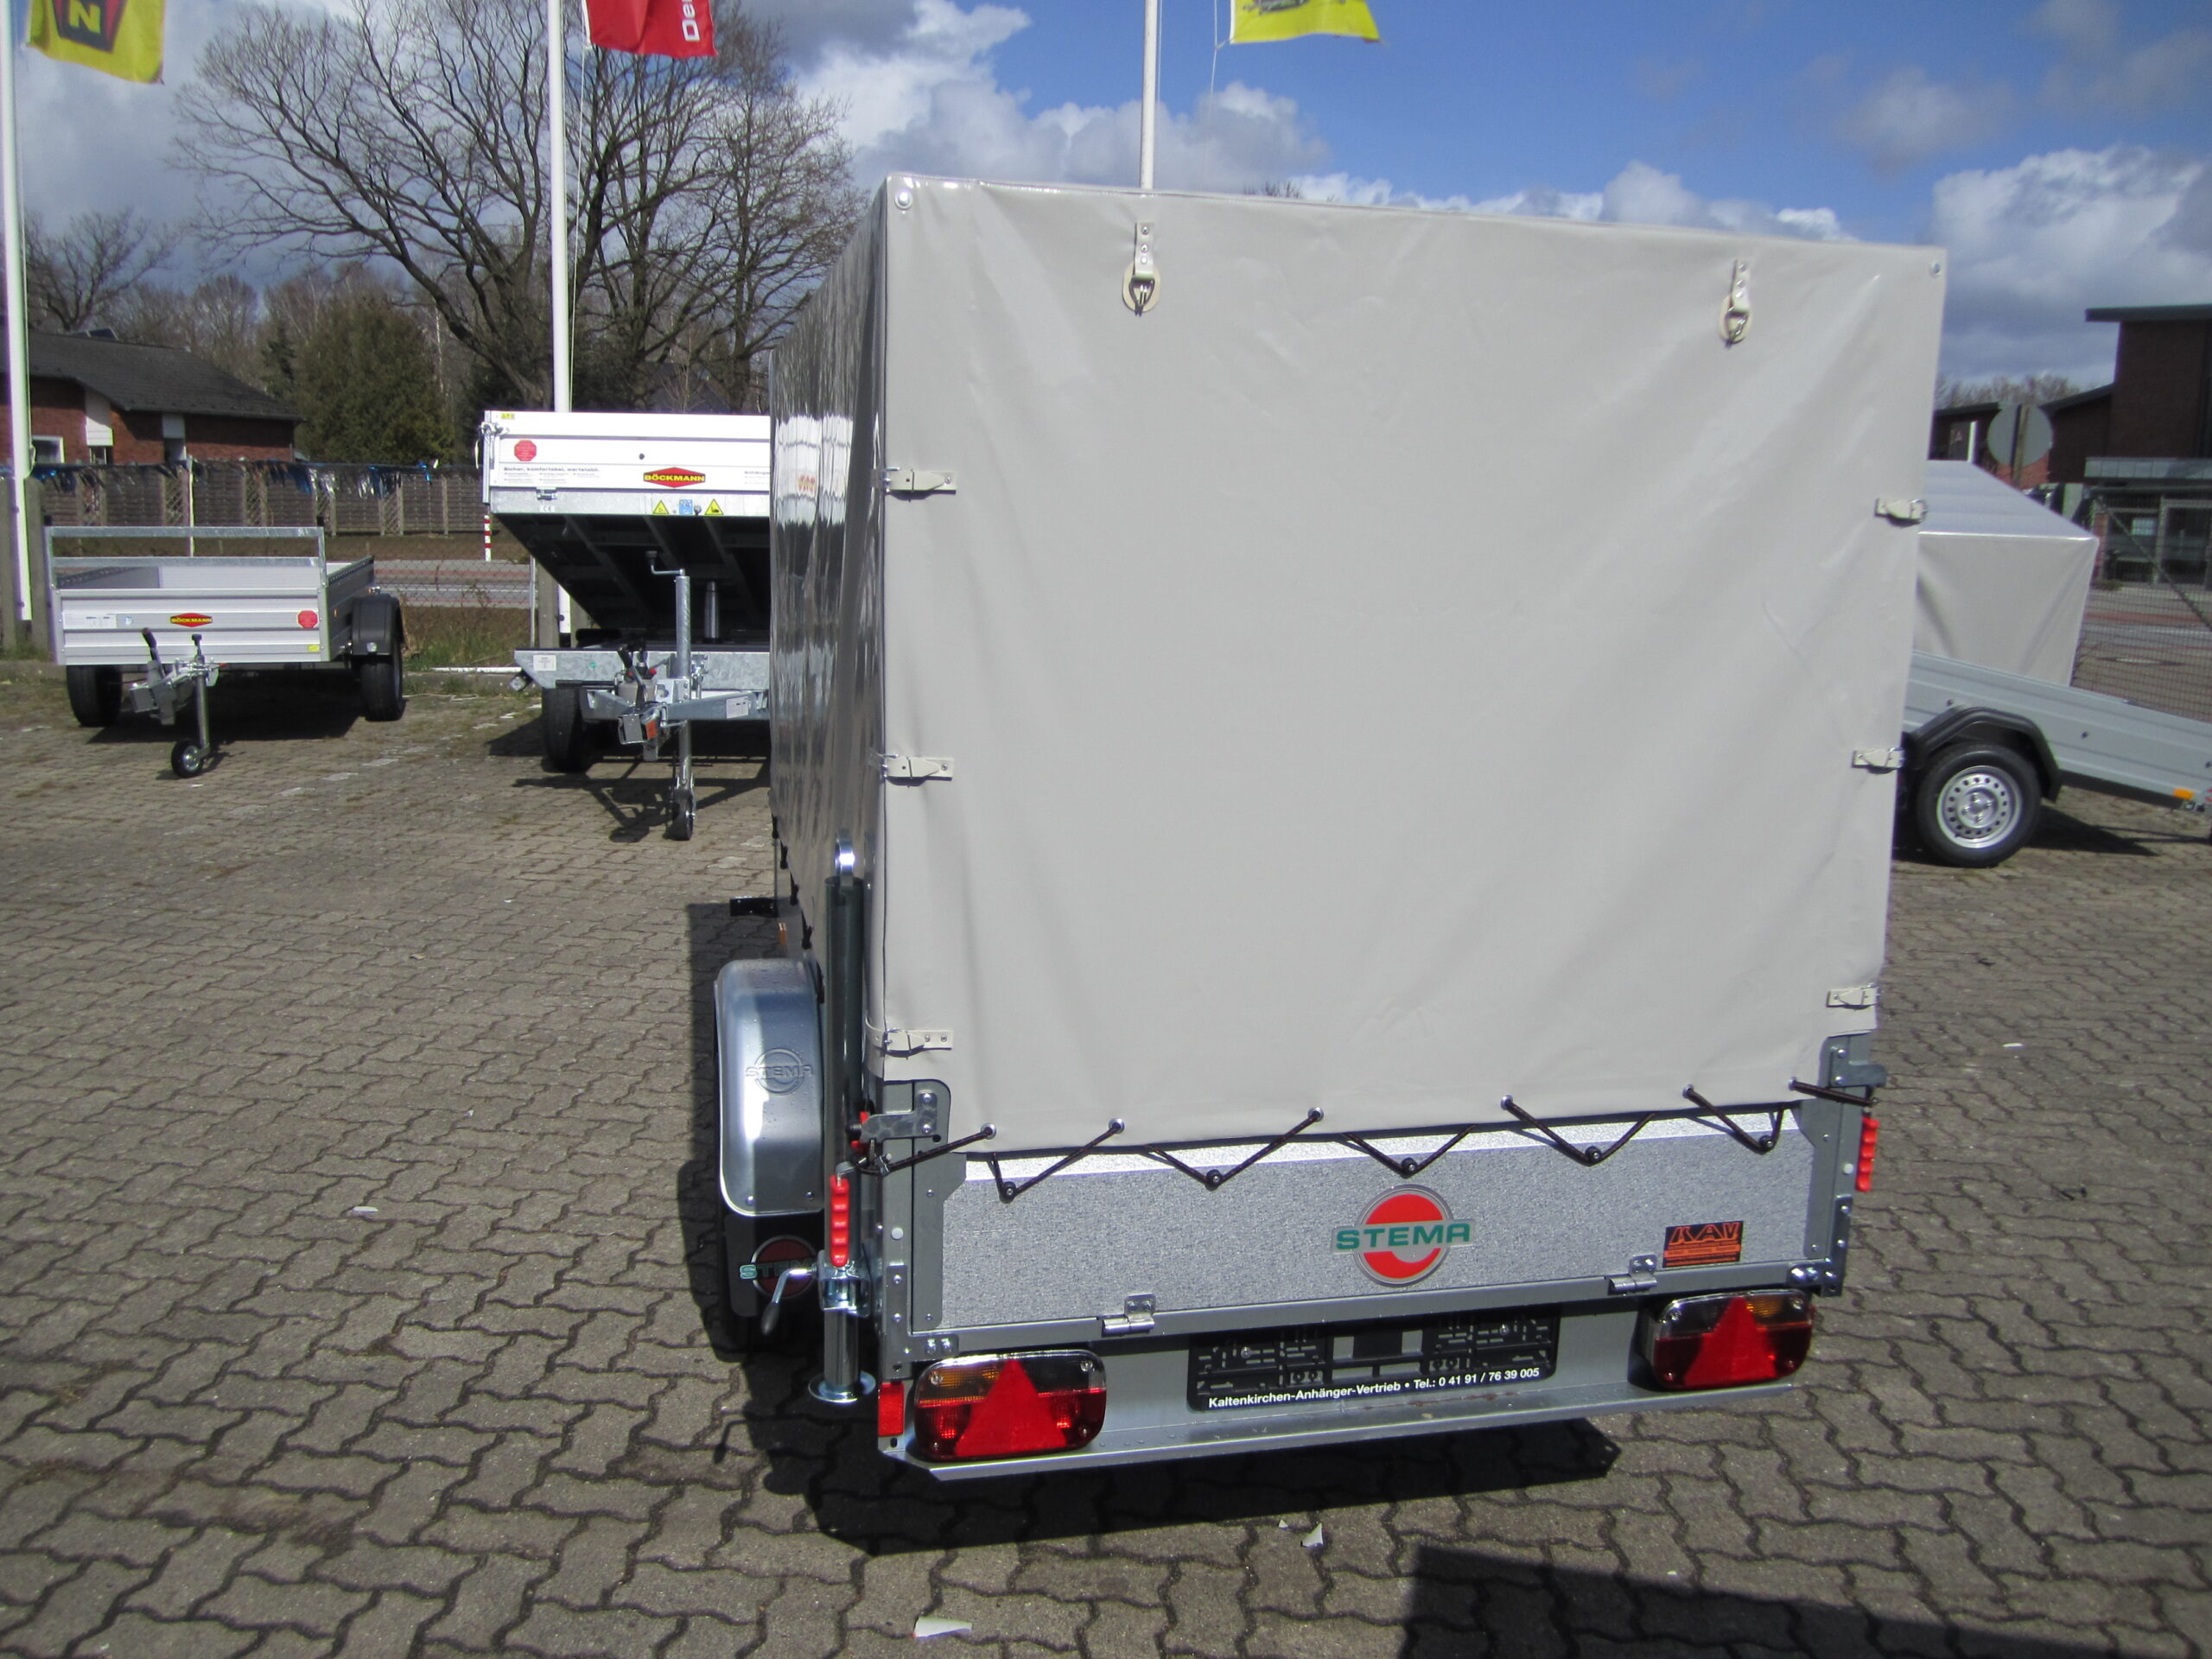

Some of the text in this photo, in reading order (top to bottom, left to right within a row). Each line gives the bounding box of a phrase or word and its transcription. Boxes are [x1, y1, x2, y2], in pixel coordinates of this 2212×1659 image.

[644, 474, 705, 482] BÖCKMANN
[745, 1064, 814, 1079] STEMA
[1336, 1223, 1471, 1249] STEMA
[1209, 1381, 1402, 1408] Kaltenkirchen-Anhänger-Vertrieb
[1413, 1378, 1436, 1389] Tel.:
[1438, 1376, 1446, 1387] 0
[1448, 1375, 1461, 1385] 41
[1464, 1373, 1478, 1384] 91
[1488, 1370, 1502, 1382] 76
[1504, 1369, 1517, 1380] 39
[1520, 1367, 1540, 1379] 005
